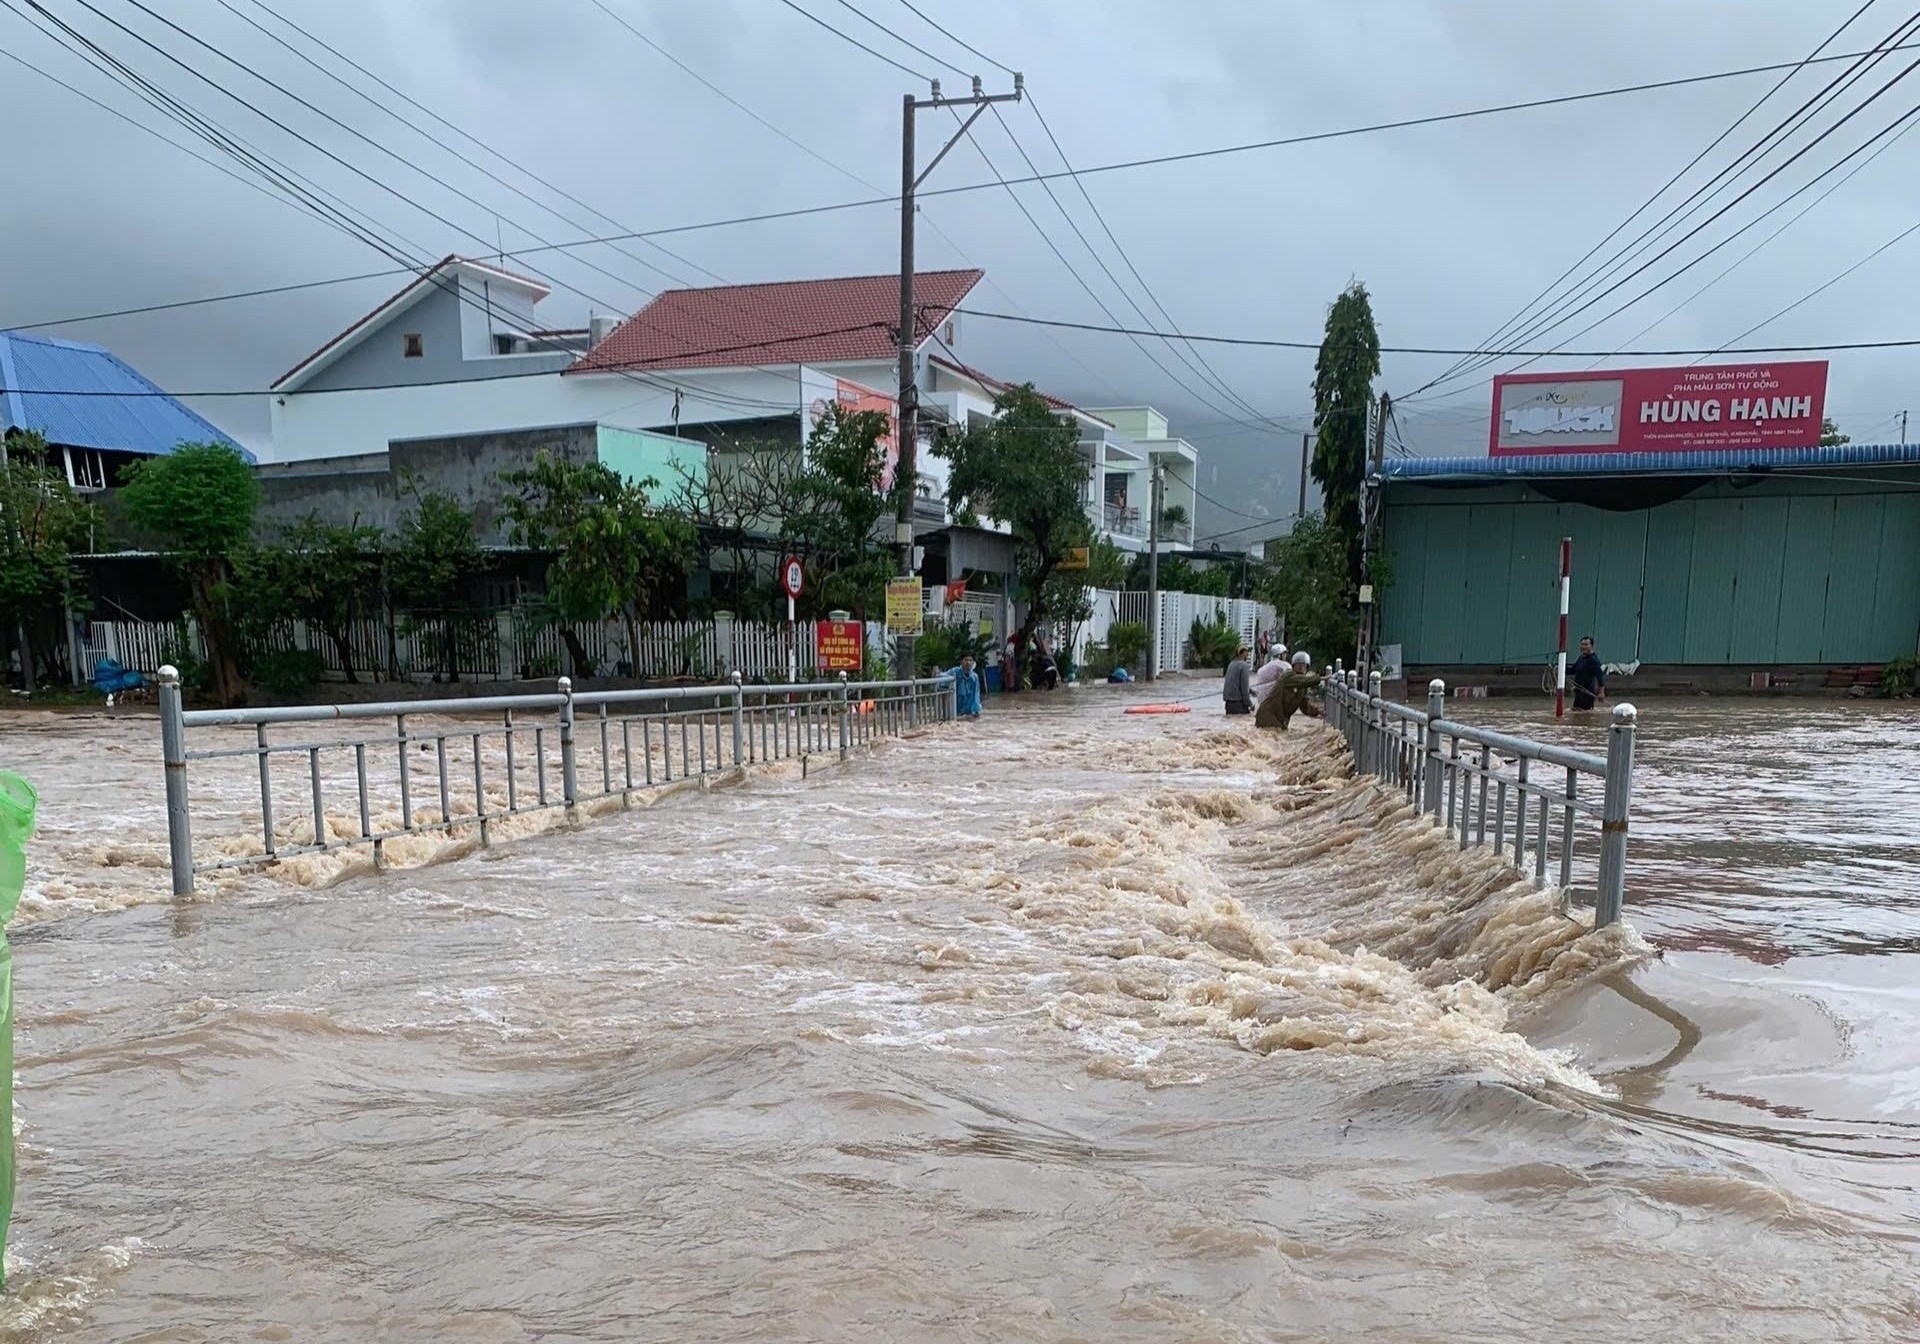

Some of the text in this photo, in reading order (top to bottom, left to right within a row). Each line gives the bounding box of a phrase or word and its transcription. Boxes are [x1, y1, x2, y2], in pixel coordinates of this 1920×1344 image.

[1684, 368, 1771, 381] TRUNG TÂM PHỐI VÀ
[1693, 382, 1713, 391] MÀU
[1715, 382, 1735, 390] SƠN
[1737, 381, 1751, 391] TỰ
[1753, 380, 1778, 391] ĐỘNG
[1640, 394, 1811, 426] HÙNG HẠNH
